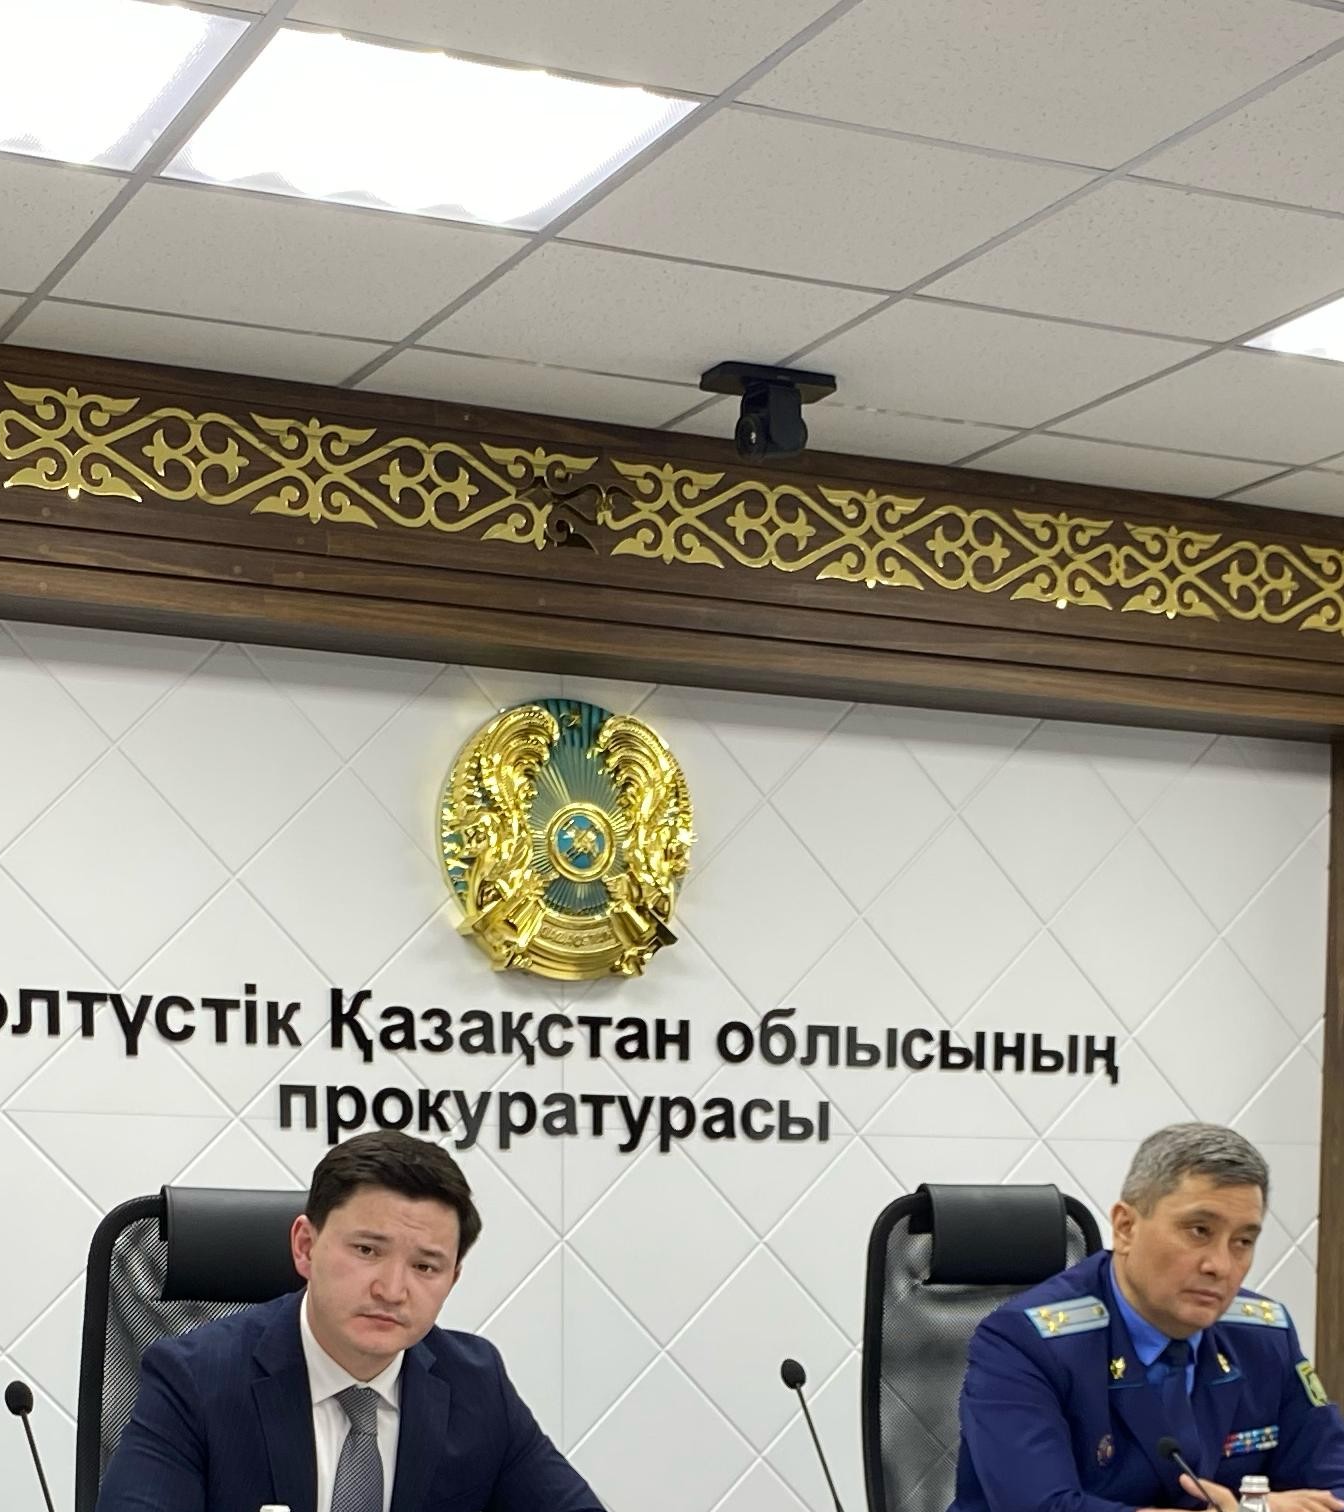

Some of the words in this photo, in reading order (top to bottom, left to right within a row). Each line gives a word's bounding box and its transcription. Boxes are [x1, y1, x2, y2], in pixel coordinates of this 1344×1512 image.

[329, 987, 693, 1068] Қазақстан
[716, 1005, 1120, 1083] облысының
[278, 1073, 832, 1149] прокуратурасы
